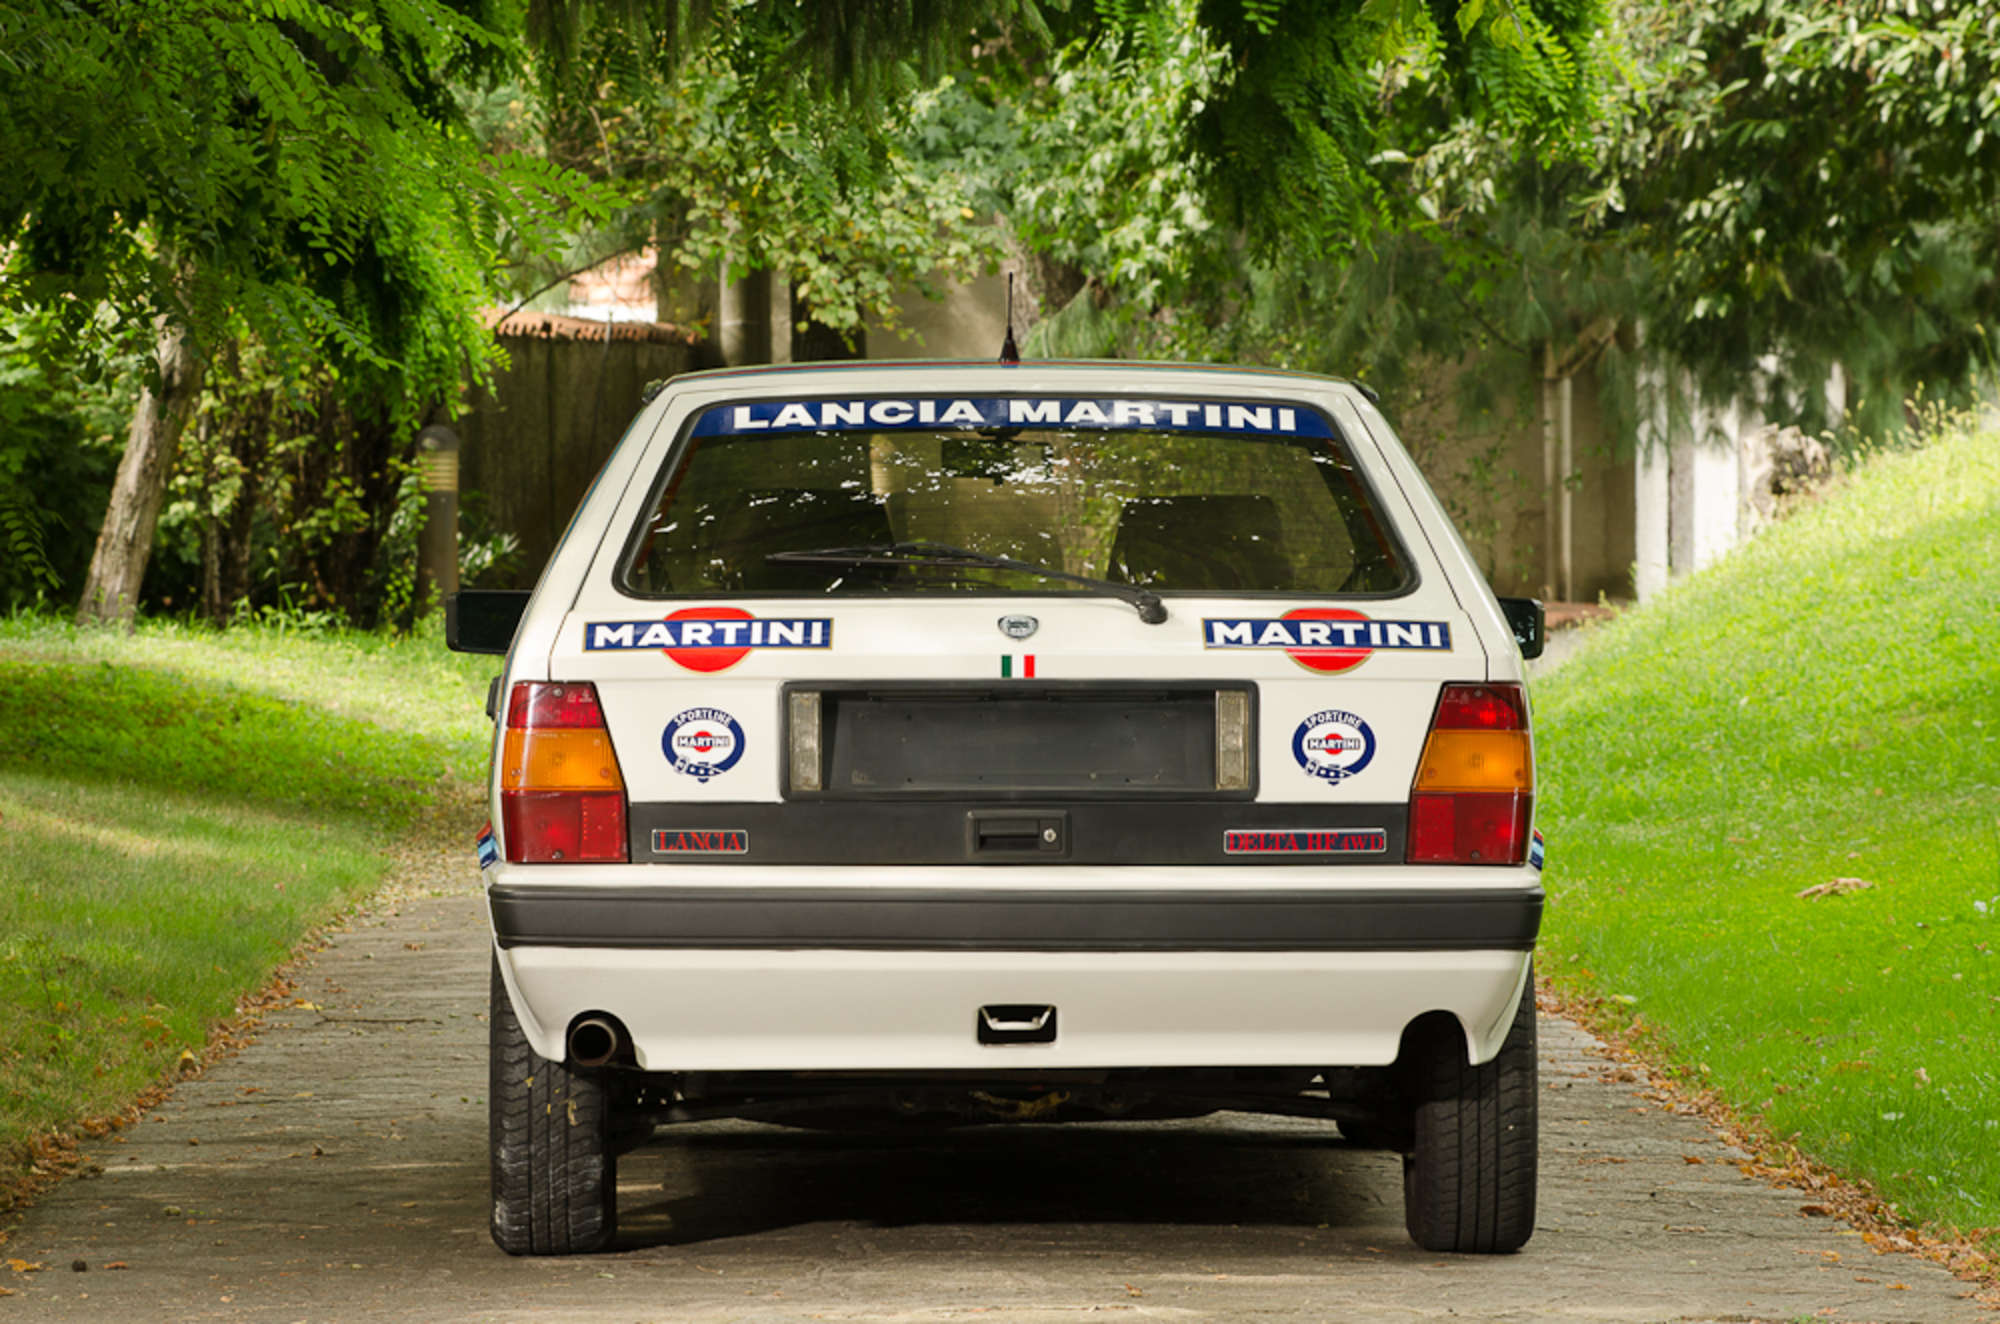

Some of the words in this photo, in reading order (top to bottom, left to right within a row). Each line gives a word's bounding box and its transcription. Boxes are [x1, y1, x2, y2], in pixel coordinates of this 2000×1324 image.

[733, 401, 985, 429] LANCIA
[1009, 400, 1296, 430] MARTINI
[593, 621, 824, 647] MARTINI
[1212, 621, 1442, 647] MARTINI
[674, 709, 734, 726] SPORTLINE
[679, 736, 729, 747] MARTINI
[1309, 739, 1360, 749] MARTINI
[659, 831, 743, 851] LANCIA
[1228, 833, 1300, 851] DELTA
